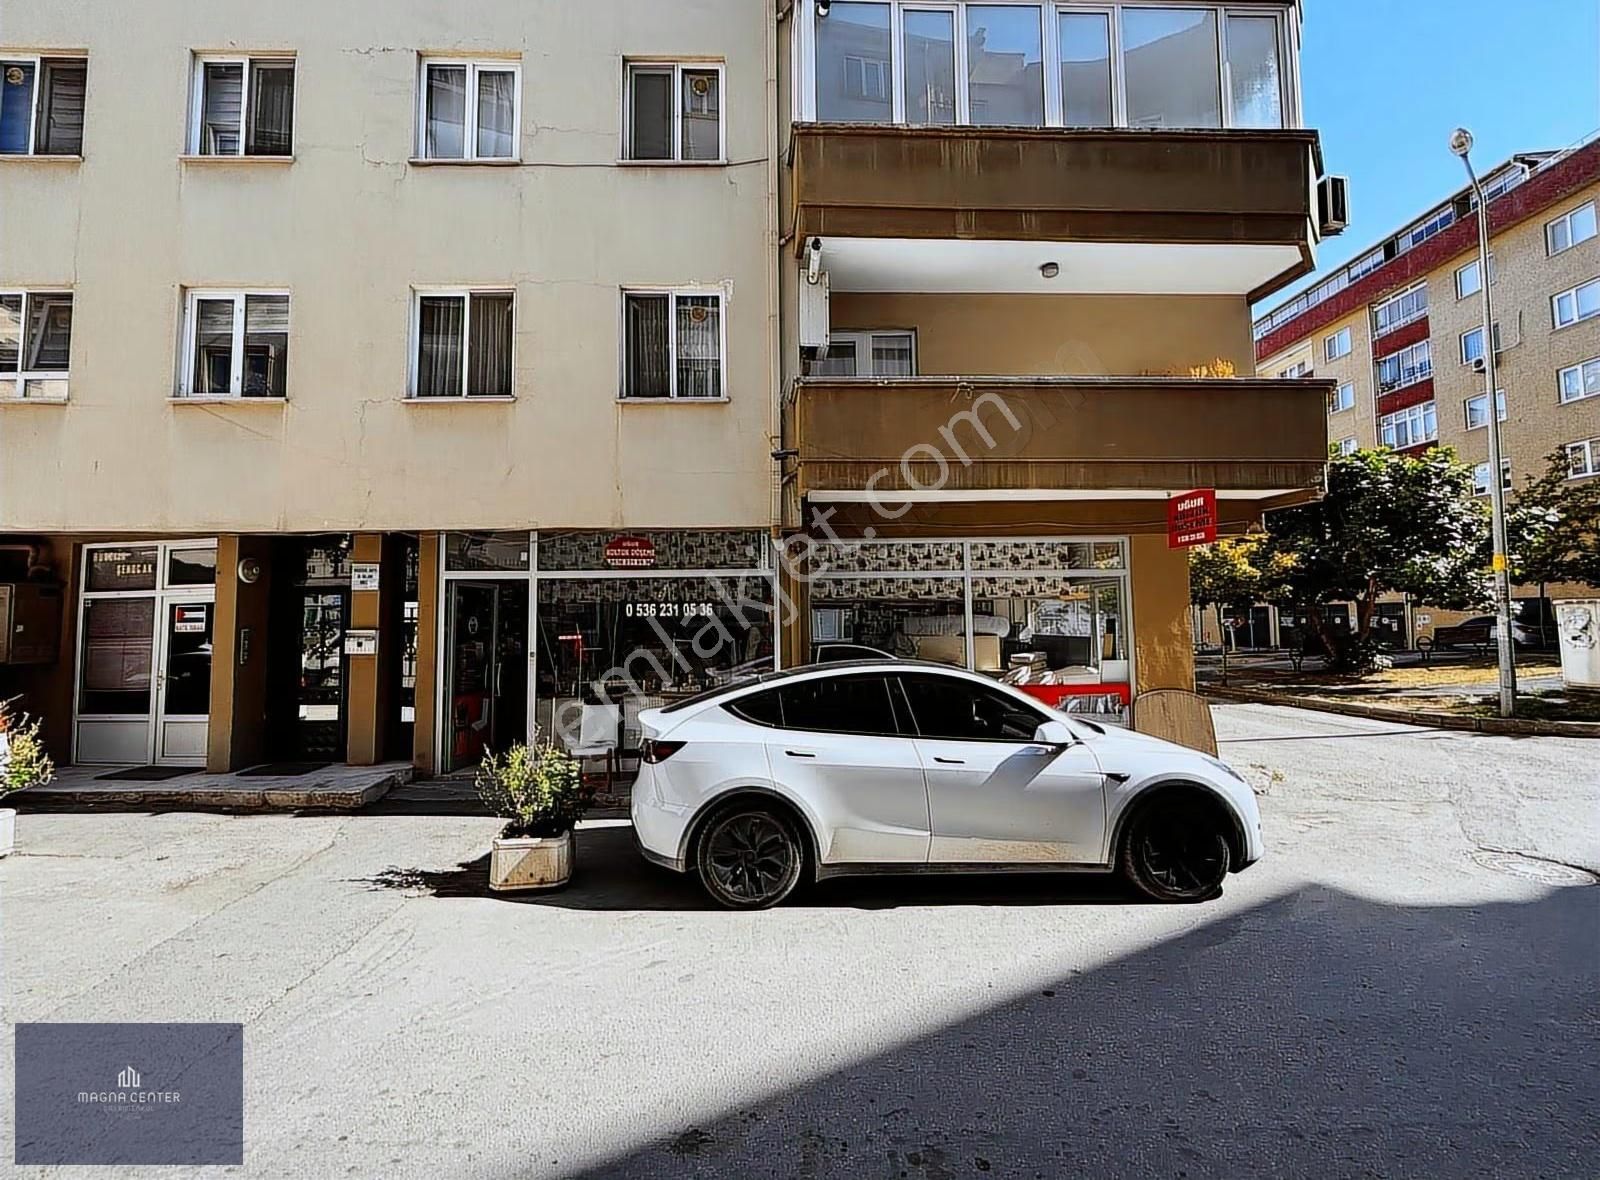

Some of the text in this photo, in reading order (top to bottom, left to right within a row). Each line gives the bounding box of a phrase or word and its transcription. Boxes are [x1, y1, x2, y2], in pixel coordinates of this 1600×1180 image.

[625, 603, 713, 617] 0 536 231 05 36
